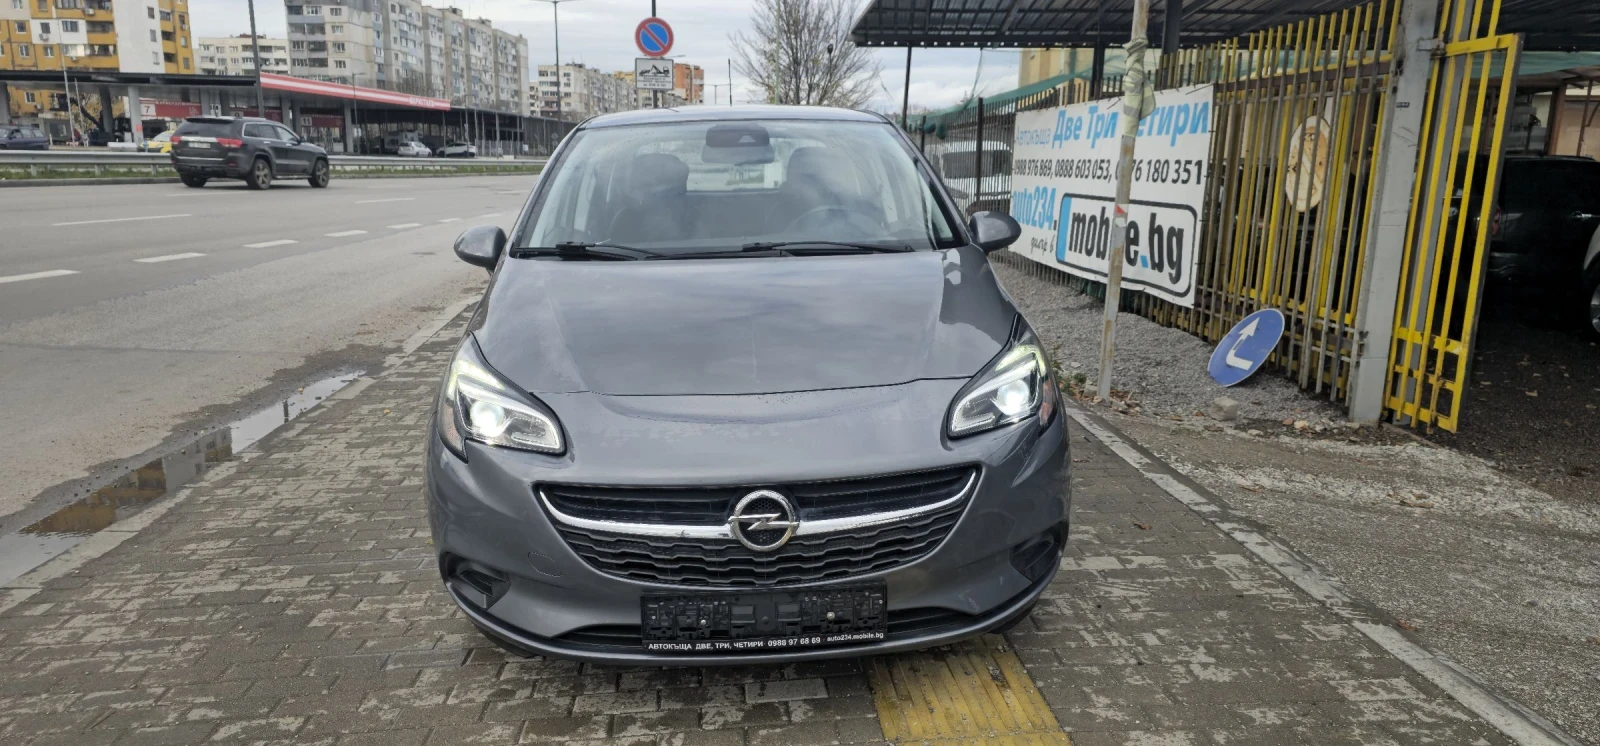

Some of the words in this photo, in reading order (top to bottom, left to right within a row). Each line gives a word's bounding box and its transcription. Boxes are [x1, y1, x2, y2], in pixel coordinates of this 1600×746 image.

[144, 105, 151, 114] 7
[1016, 127, 1051, 146] Автокъща
[1052, 109, 1083, 149] Две
[1086, 105, 1118, 148] Три
[1027, 159, 1039, 177] 976
[1039, 159, 1053, 180] 869,
[1054, 158, 1075, 178] 0888
[1075, 158, 1091, 179] 603
[1092, 159, 1112, 183] 053,
[1146, 158, 1170, 183] 180
[1171, 159, 1203, 185] 351
[1068, 206, 1184, 285] mobe.bg
[648, 643, 692, 651] АВТОКЪЩА
[695, 643, 713, 651] ДВЕ,
[715, 642, 732, 650] ТРИ,
[826, 632, 885, 642] auto234.mobile.bg
